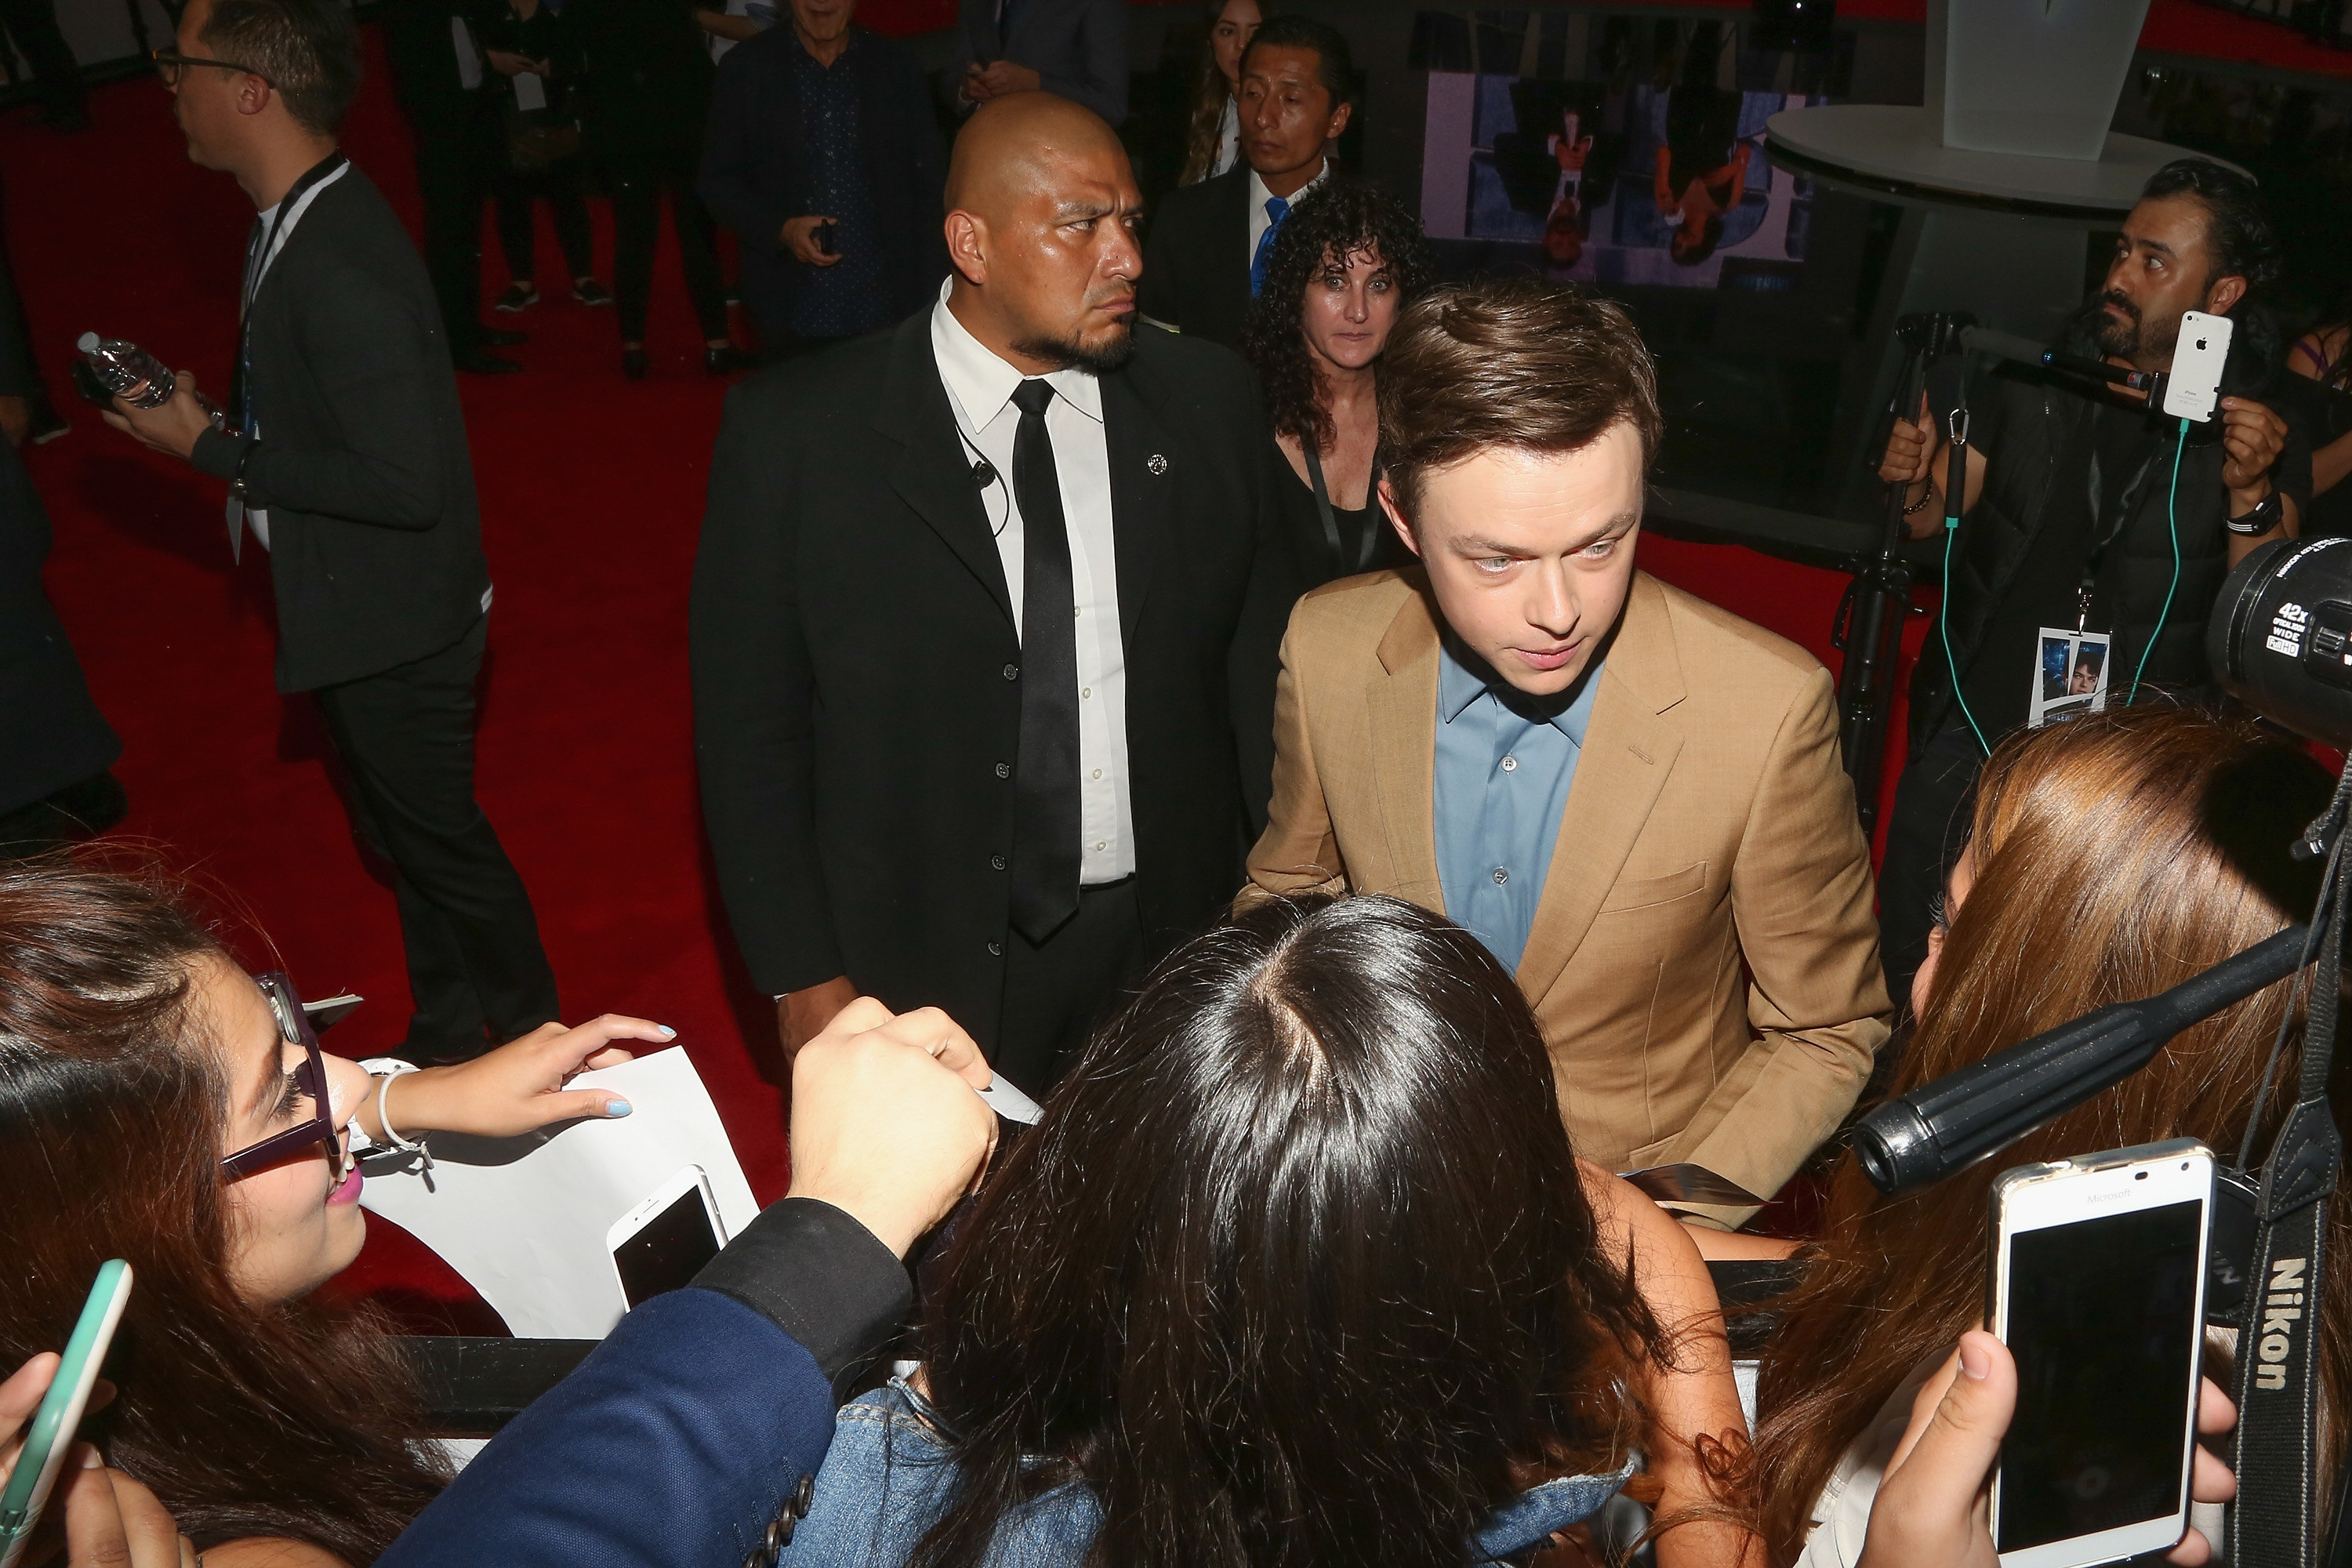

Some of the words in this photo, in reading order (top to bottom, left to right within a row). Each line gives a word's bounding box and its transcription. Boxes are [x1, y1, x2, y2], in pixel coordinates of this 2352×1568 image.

[2273, 626, 2300, 642] WIDE
[2268, 637, 2282, 650] Full
[2282, 641, 2297, 655] HD
[2087, 1188, 2132, 1204] Microsoft
[2256, 1258, 2307, 1390] Nikon
